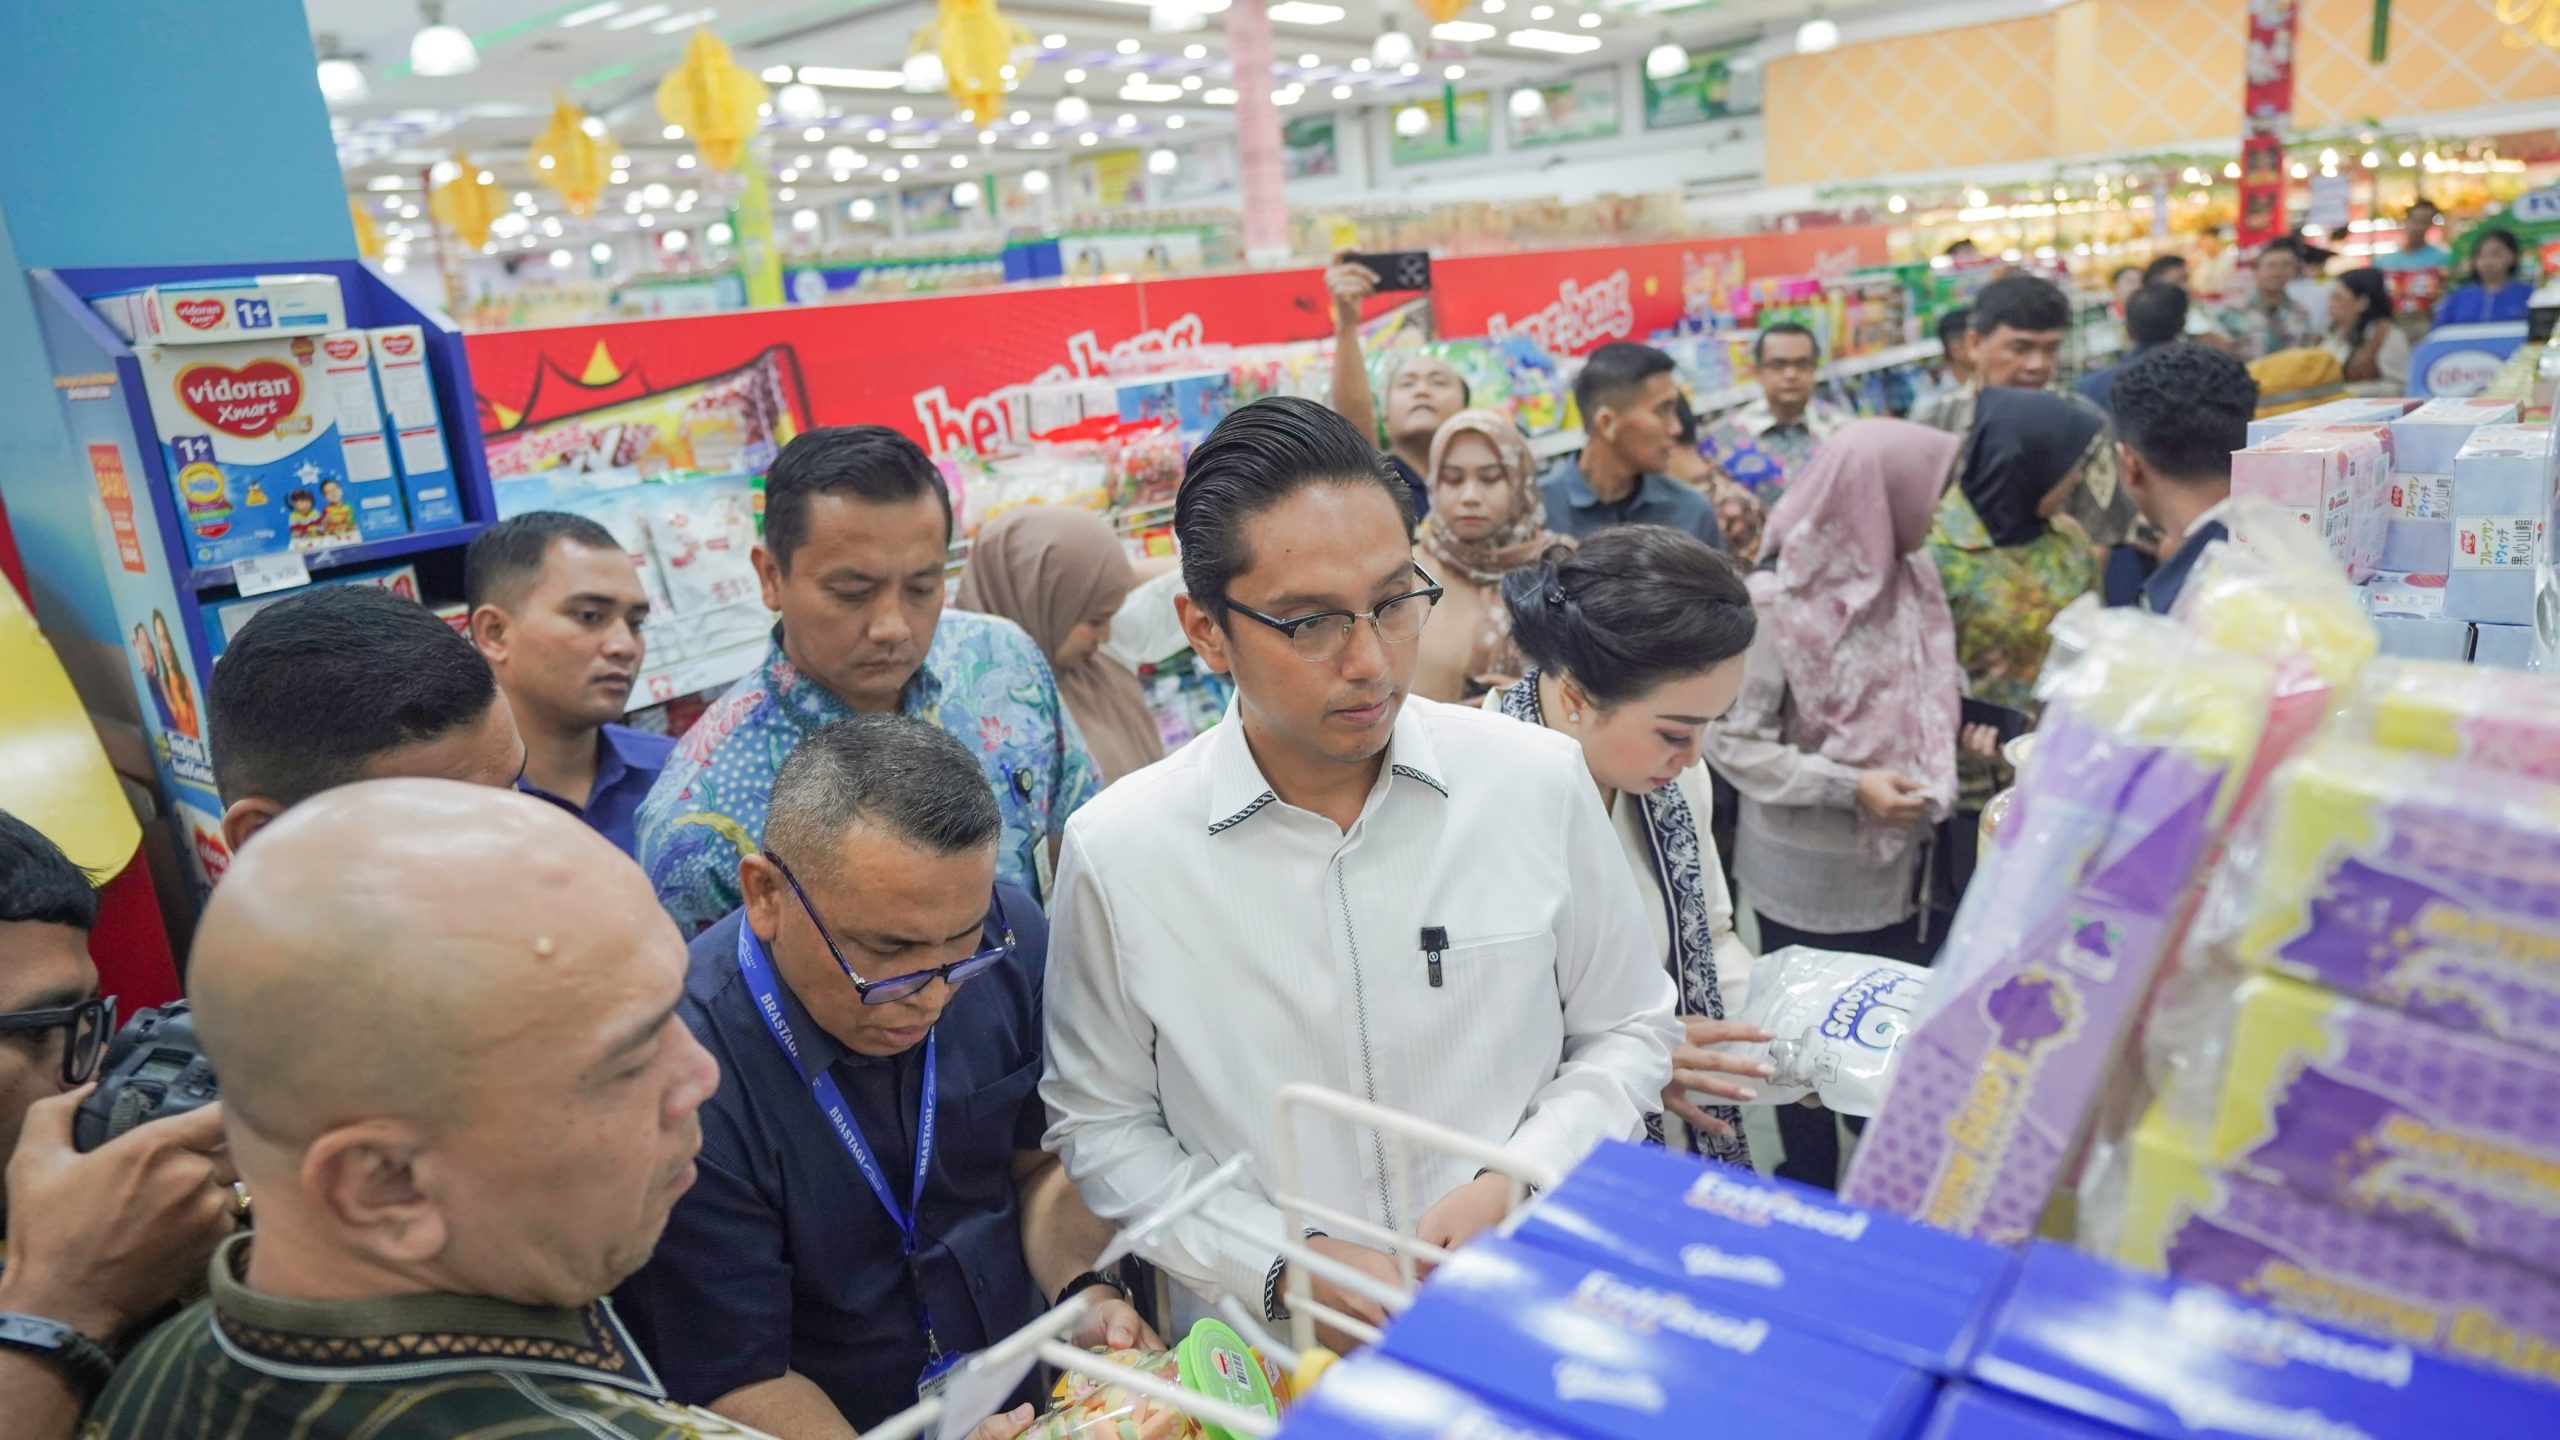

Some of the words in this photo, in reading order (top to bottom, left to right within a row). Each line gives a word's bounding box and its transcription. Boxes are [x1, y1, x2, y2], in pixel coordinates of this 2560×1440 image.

[238, 302, 267, 327] 1+
[187, 377, 293, 404] vidoran
[218, 399, 278, 424] Xmart
[179, 438, 209, 462] 1+
[2479, 518, 2494, 566] フルーツサン
[829, 1106, 866, 1165] BRASTAGI
[919, 1108, 933, 1177] BRASTAGI
